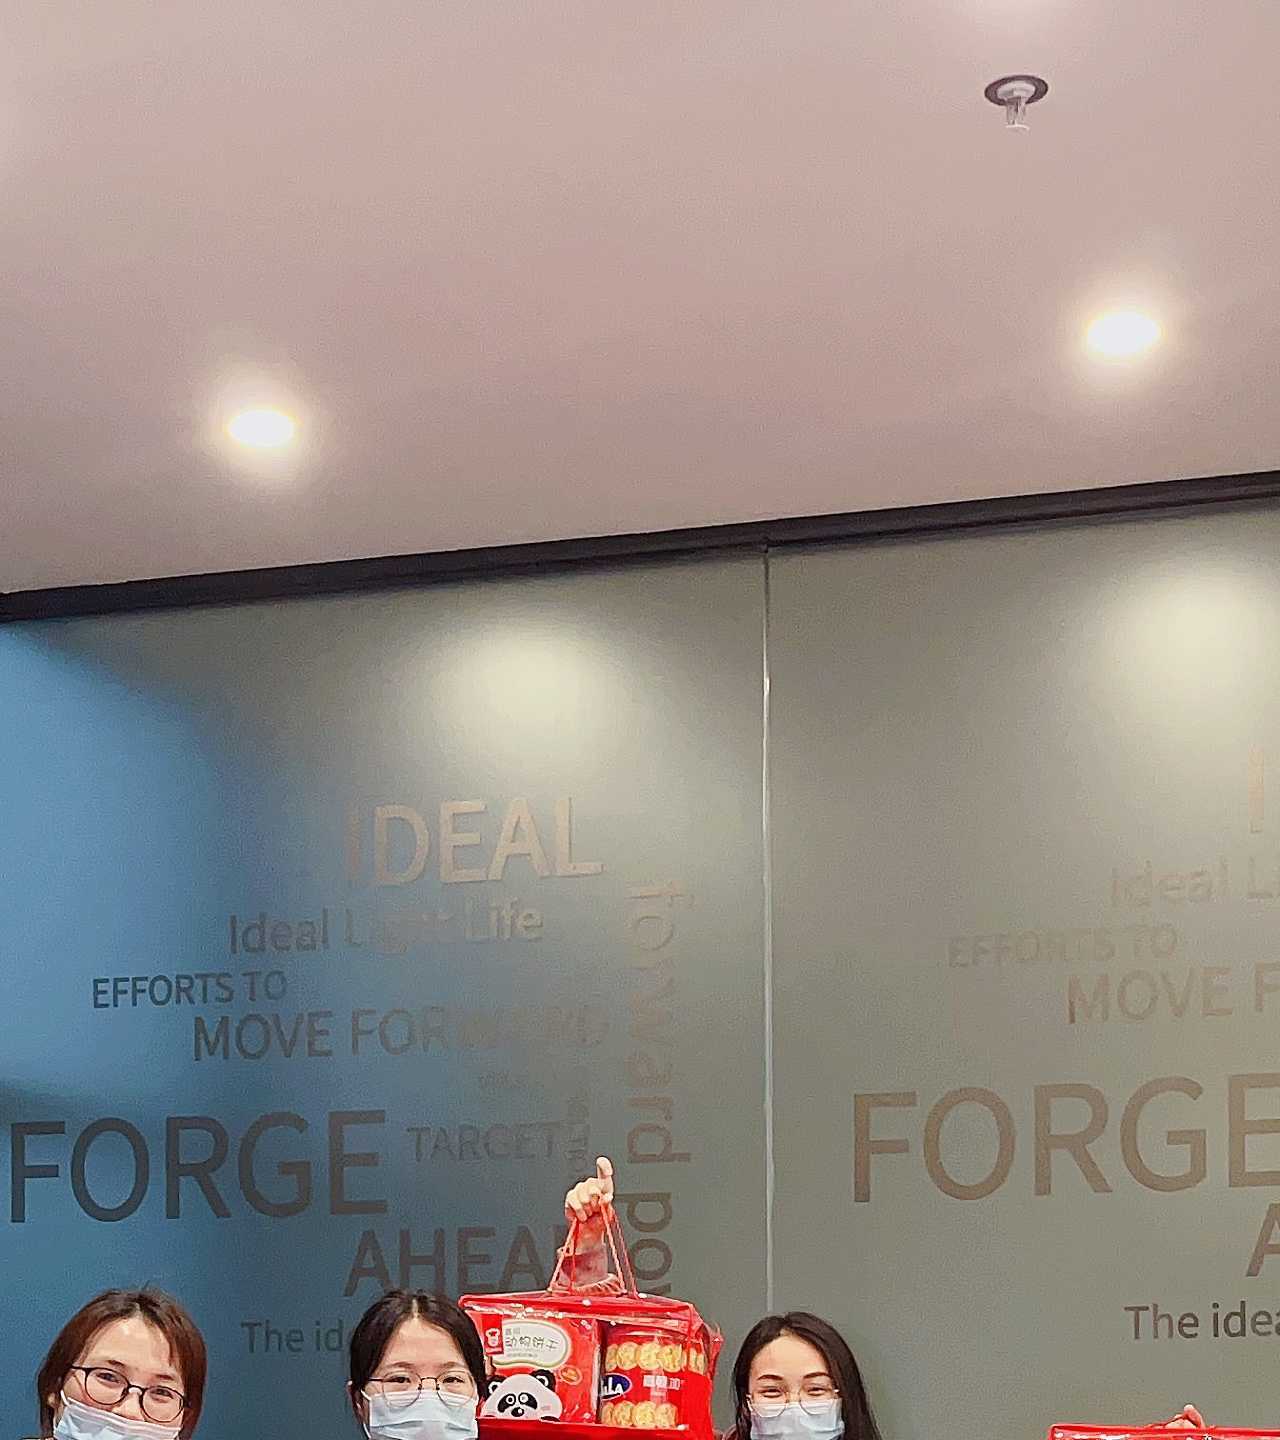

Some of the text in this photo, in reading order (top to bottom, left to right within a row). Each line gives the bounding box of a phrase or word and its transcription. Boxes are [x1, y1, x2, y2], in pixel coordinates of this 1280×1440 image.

[345, 798, 604, 887] IDEAL
[1111, 860, 1230, 910] Ideal
[229, 911, 328, 954] Ideal
[464, 897, 543, 944] Life
[948, 923, 1179, 970] EFFORTS TO
[92, 970, 288, 1009] EFFORTS TO
[1067, 966, 1232, 1025] MOVE
[194, 1013, 334, 1062] MOVE
[9, 1109, 389, 1224] FORGE
[406, 1119, 566, 1165] TARGET
[343, 1225, 565, 1299] AHEA
[240, 1320, 306, 1354] The
[1126, 1304, 1201, 1341] The
